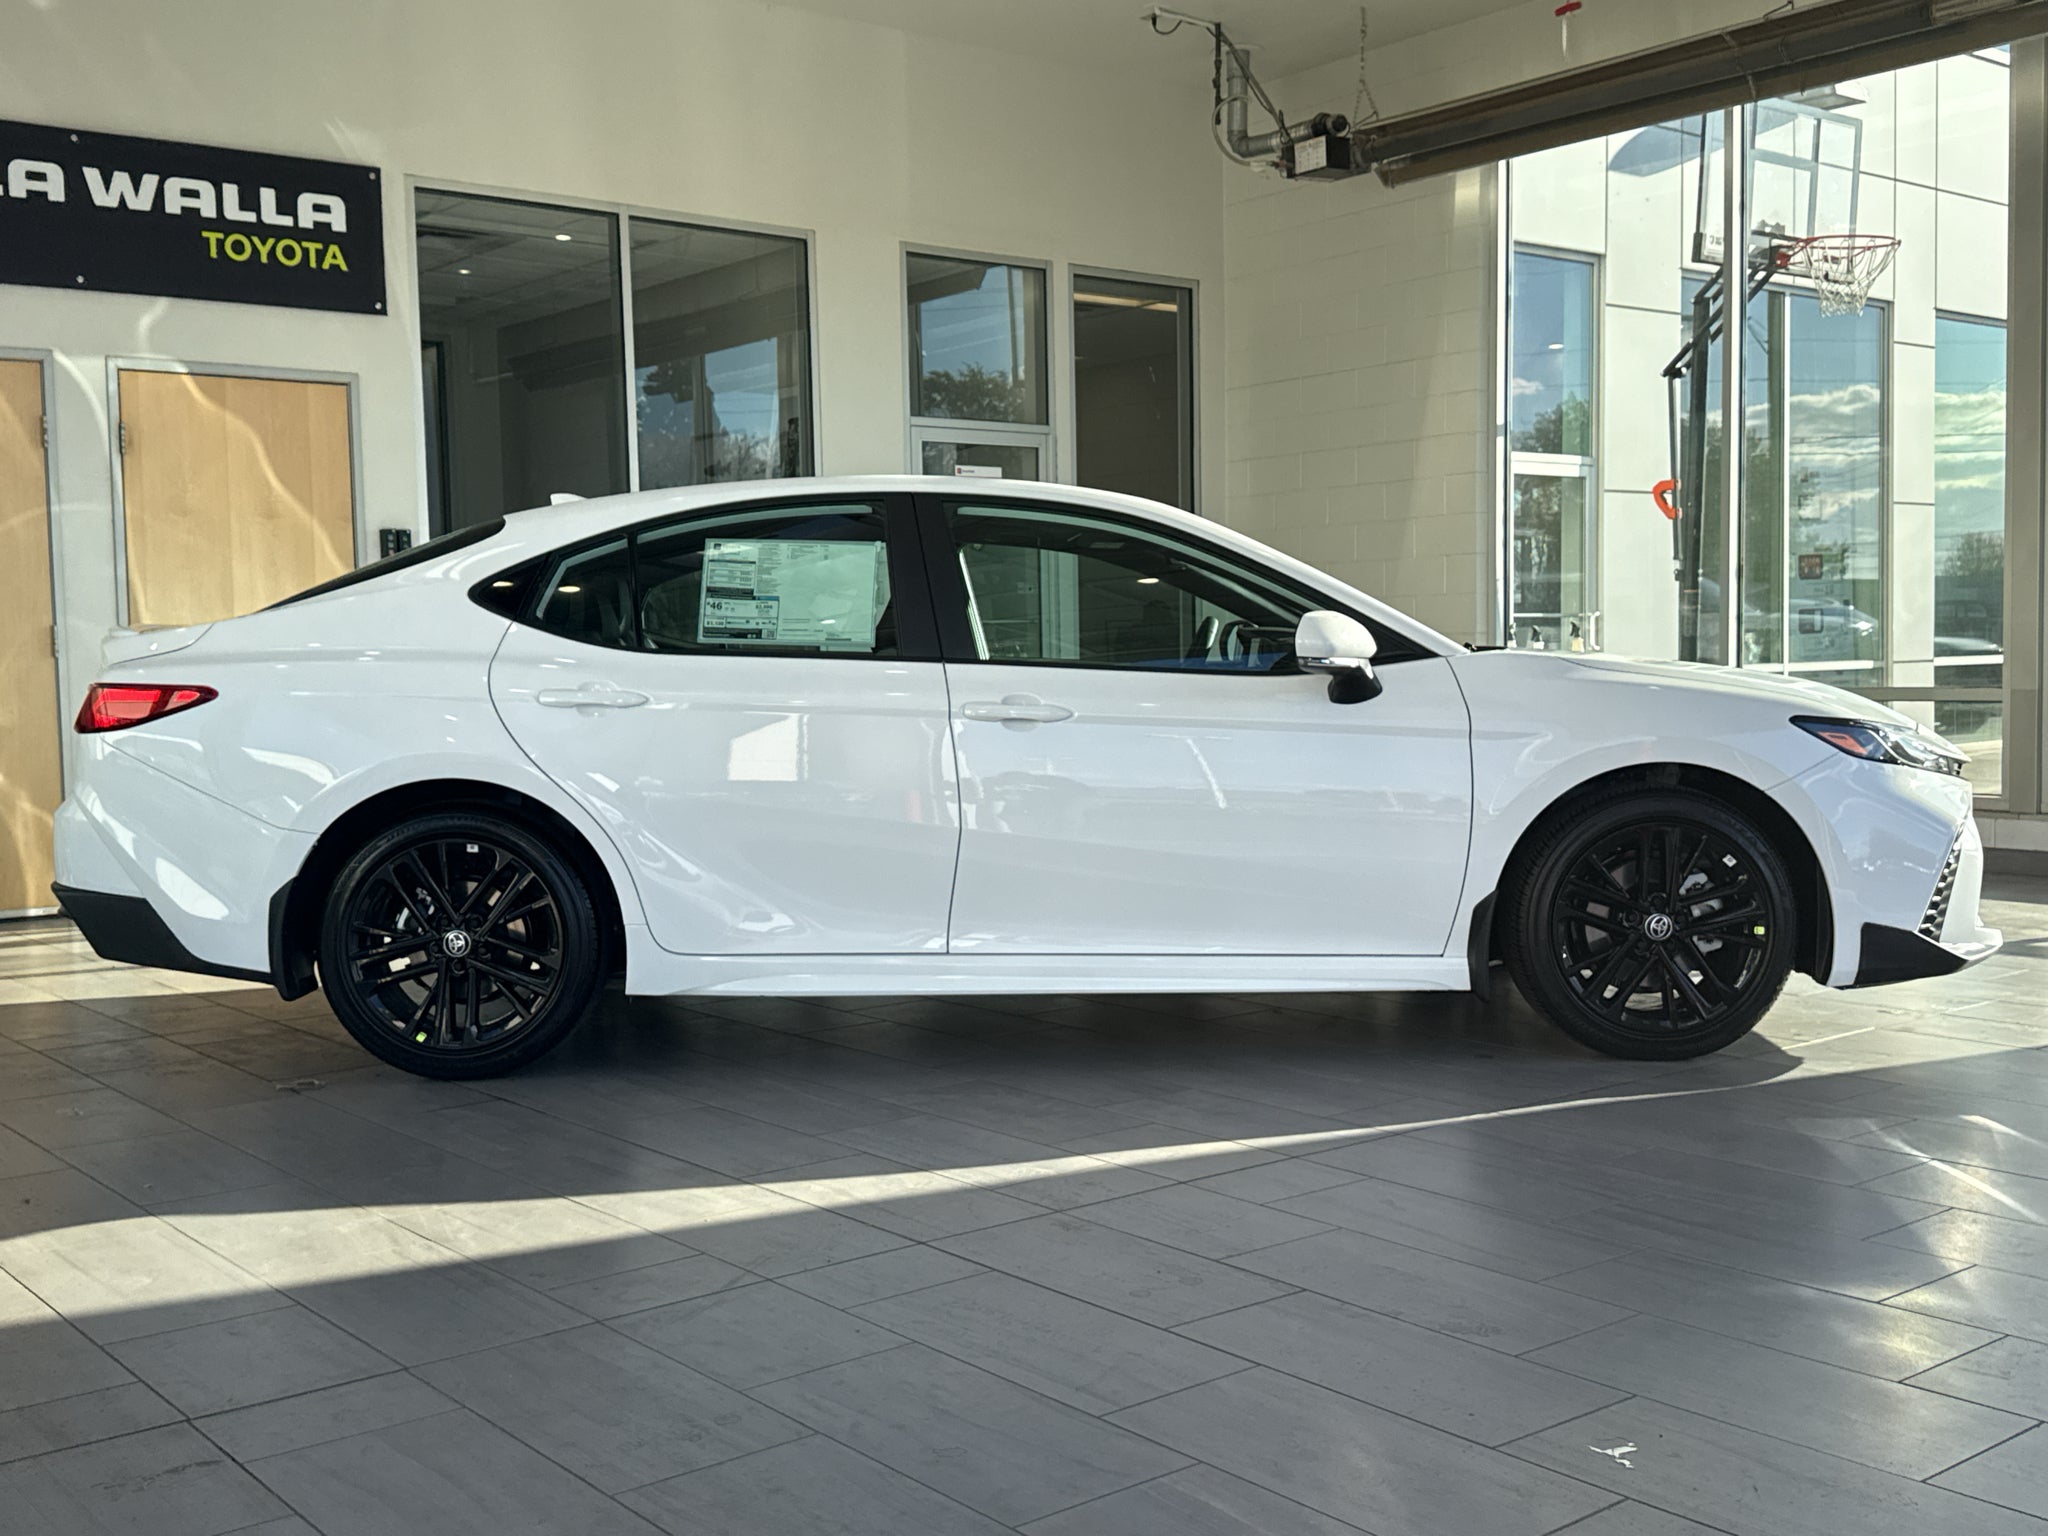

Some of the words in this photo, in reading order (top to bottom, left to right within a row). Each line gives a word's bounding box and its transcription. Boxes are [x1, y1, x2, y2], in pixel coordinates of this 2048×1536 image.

[0, 159, 65, 202] A
[82, 166, 347, 232] WALLA
[201, 230, 348, 272] TOYOTA
[710, 601, 723, 611] 46
